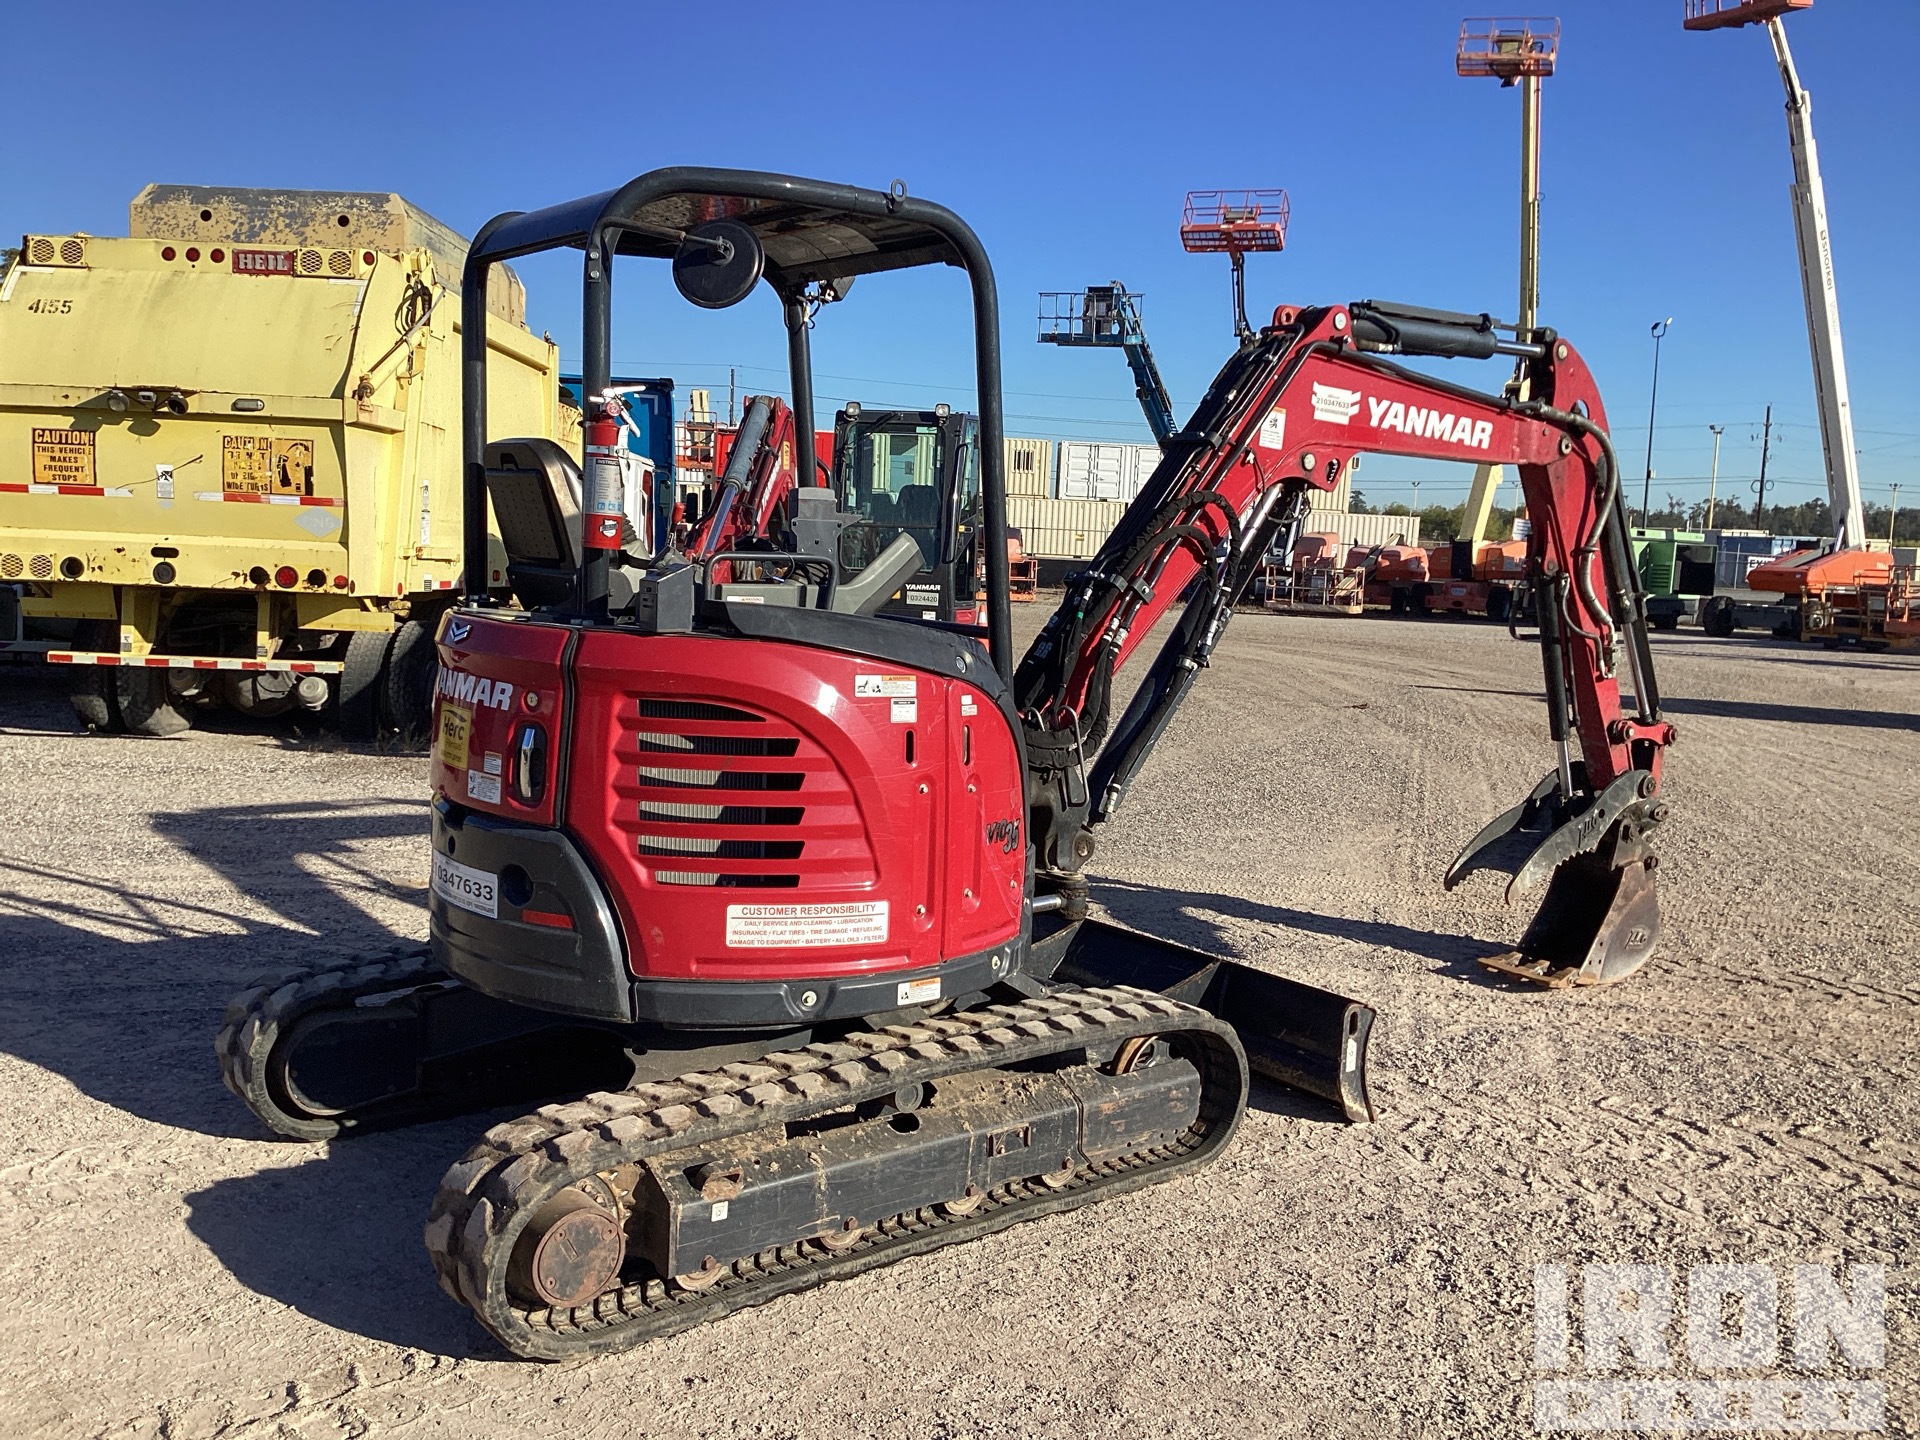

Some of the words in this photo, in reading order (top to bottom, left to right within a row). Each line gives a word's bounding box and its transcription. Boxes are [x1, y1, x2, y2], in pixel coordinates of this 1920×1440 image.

[238, 253, 287, 271] HEIL
[27, 298, 74, 315] 4155
[1368, 396, 1493, 449] YANMAR
[34, 429, 94, 446] CAUTION!
[224, 436, 269, 450] CAUTIN
[36, 445, 55, 454] THIS
[49, 455, 79, 464] MAKES
[43, 464, 86, 474] FREQUENT
[51, 474, 78, 482] STOPS
[905, 583, 941, 591] YANMAR
[741, 906, 798, 916] CUSTOMER
[800, 904, 877, 916] RESPONSIBILITY
[837, 917, 874, 925] LUBRICATION
[852, 925, 883, 934] REFUELING
[766, 938, 801, 946] EQUIPMENT
[805, 937, 832, 945] BATTERY
[835, 936, 846, 944] ALL
[863, 934, 886, 942] FILTERS
